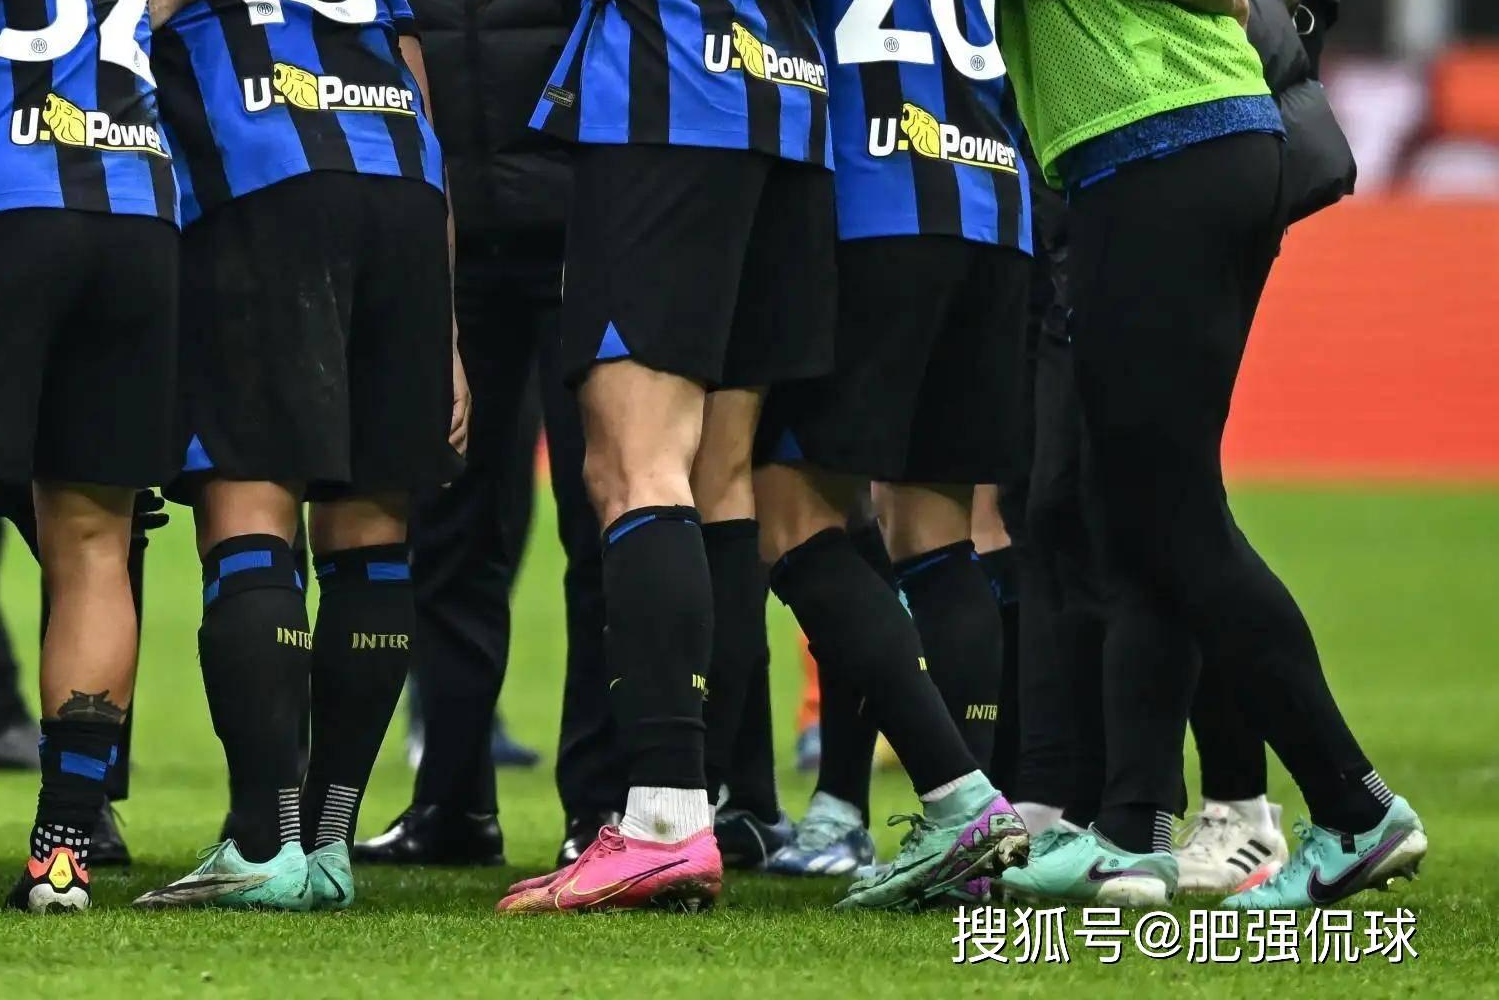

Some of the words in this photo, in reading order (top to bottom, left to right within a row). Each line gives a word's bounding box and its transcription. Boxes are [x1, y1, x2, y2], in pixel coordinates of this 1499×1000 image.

[762, 43, 825, 87] Power
[317, 75, 414, 110] Power
[939, 123, 1016, 167] Power
[351, 632, 409, 650] INTER
